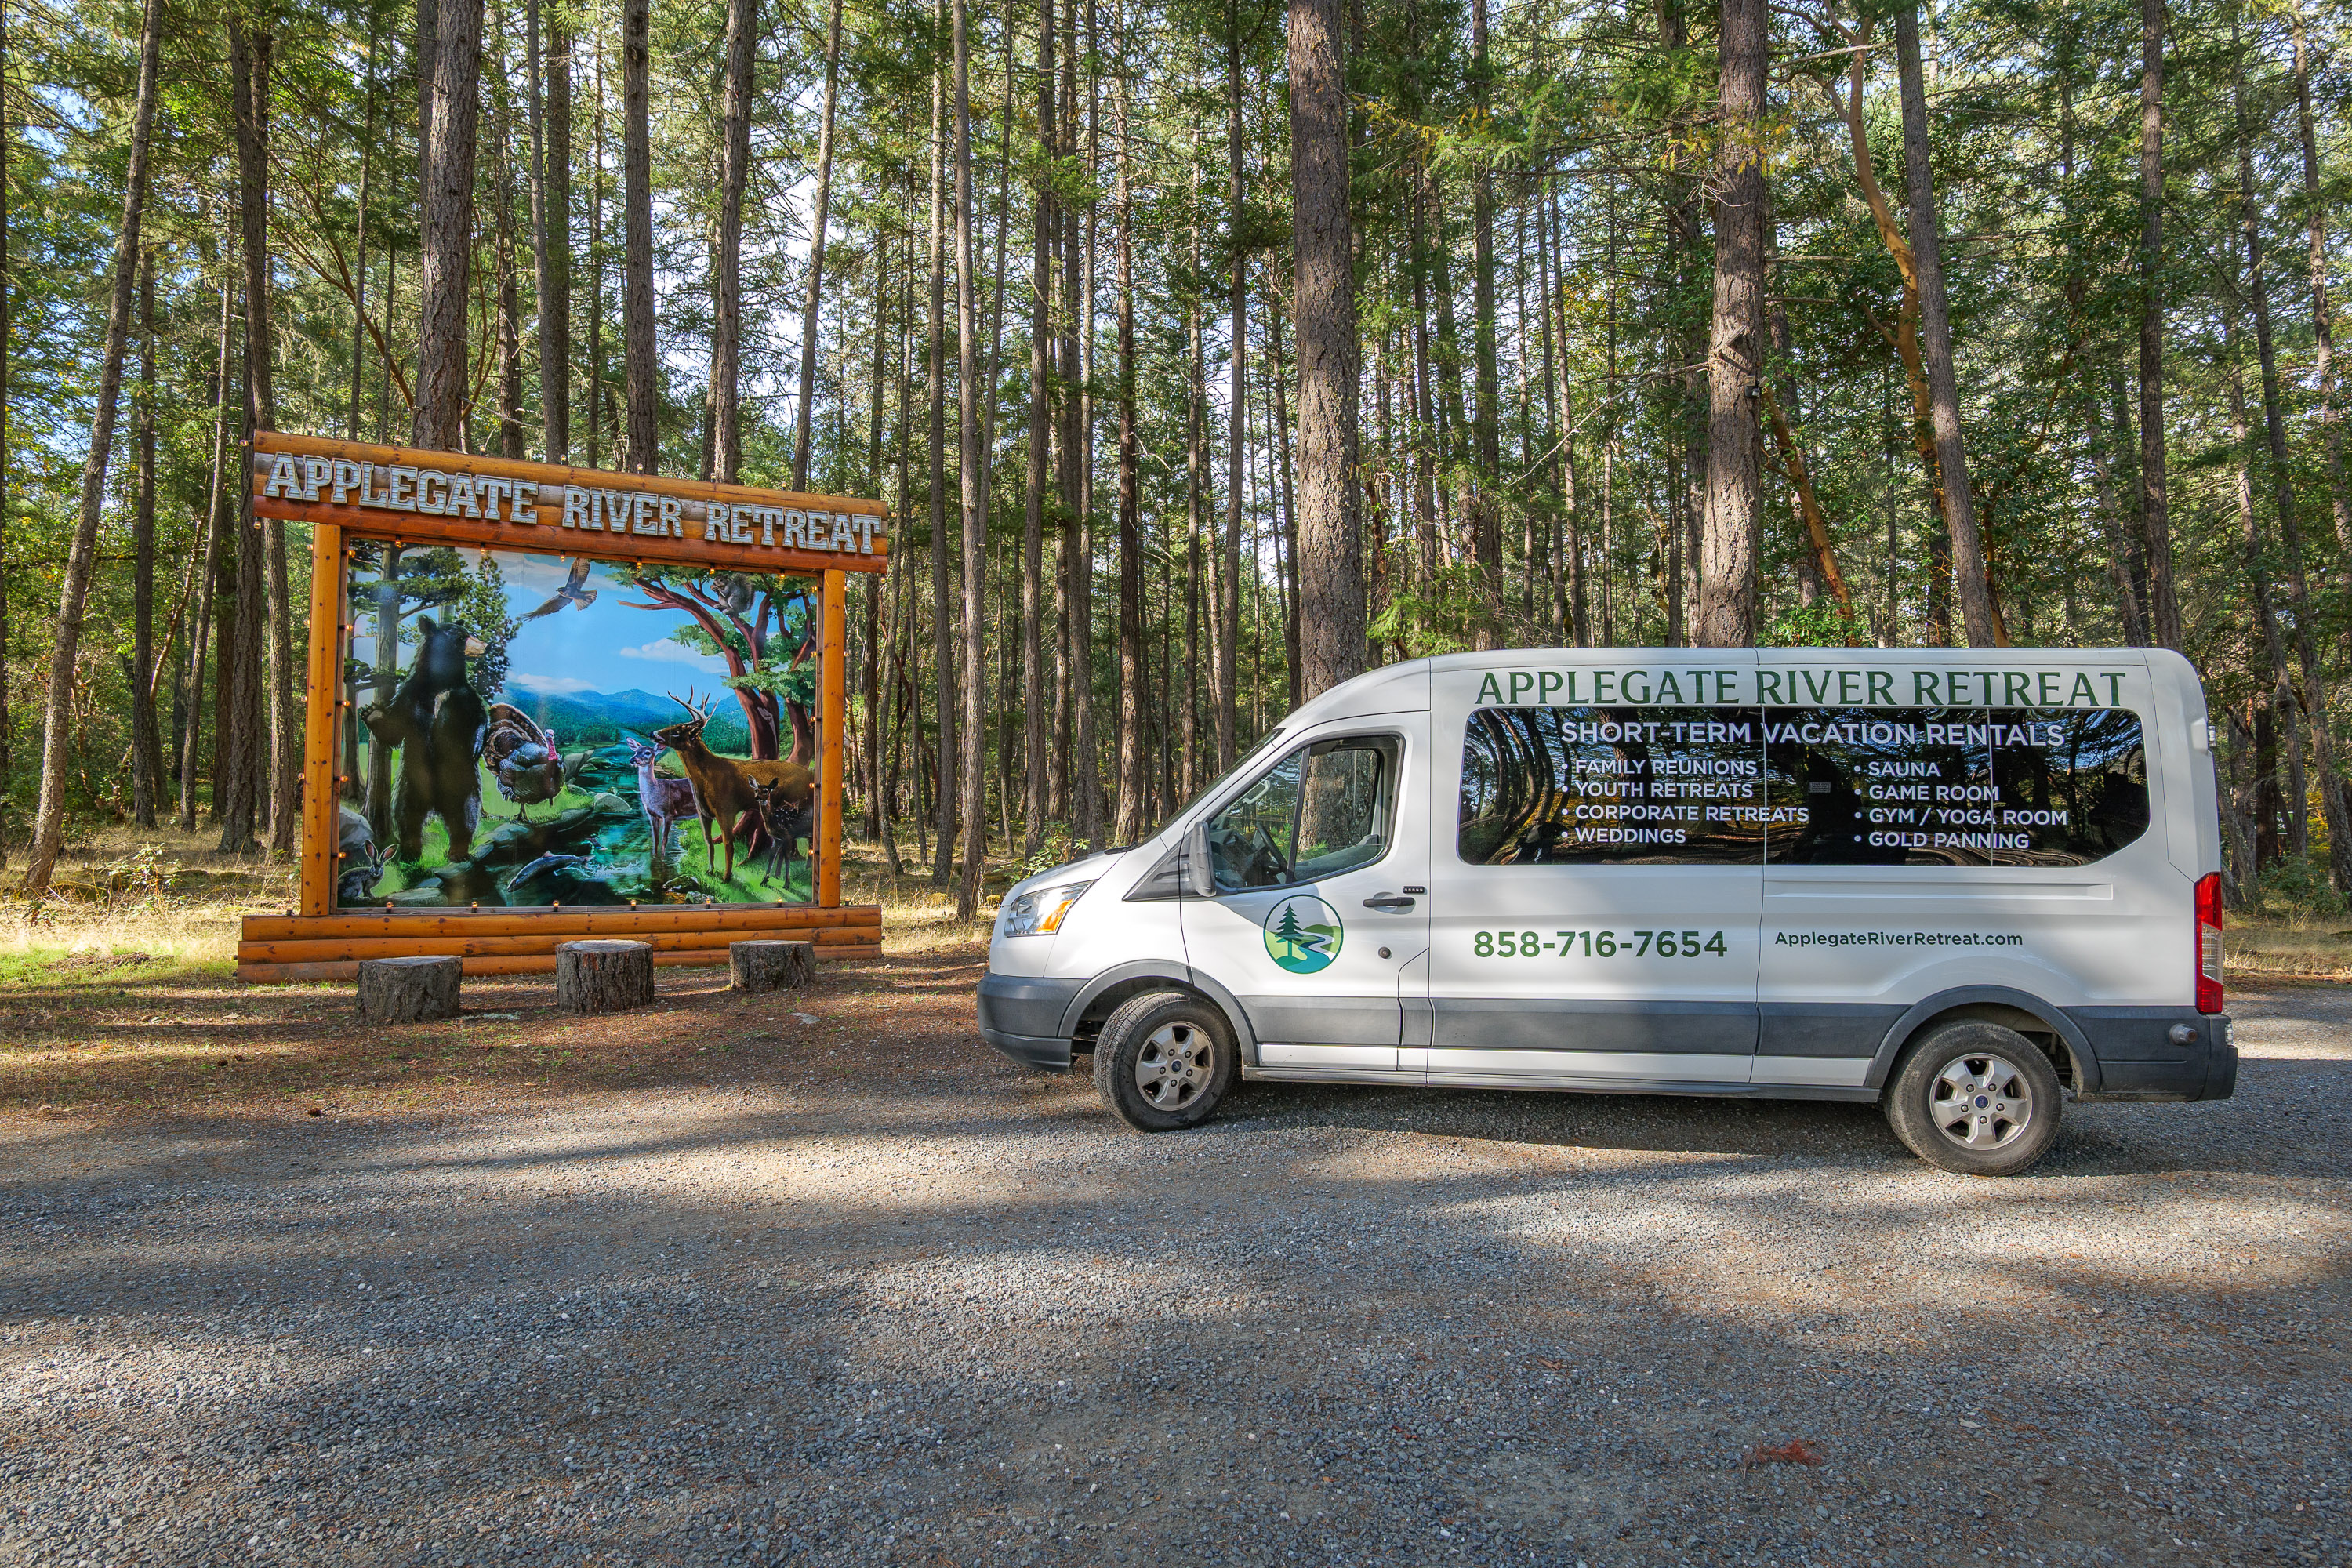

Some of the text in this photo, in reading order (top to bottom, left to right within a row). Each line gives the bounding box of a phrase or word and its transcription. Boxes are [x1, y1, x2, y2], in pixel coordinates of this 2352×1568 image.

[263, 451, 882, 554] APPLEGATE RIVER RETREAT
[1475, 670, 2126, 706] APPLEGATE RIVER RETREAT
[1561, 721, 2066, 746] SHORT-TERM VACATION RENTALS
[1576, 760, 1757, 775] FAMILY REUNIONS
[1868, 761, 1941, 777] SAUNA
[1576, 782, 1753, 798] YOUTH RETREATS
[1869, 786, 1999, 801] GAME ROOM
[1575, 804, 1809, 822] CORPORATE RETREATS
[1869, 808, 1915, 824] GYM
[1936, 809, 1996, 825] YOGA
[2003, 810, 2067, 826] ROOM
[1576, 827, 1686, 843] WEDDINGS
[1869, 832, 2029, 848] GOLD PANNING
[1473, 931, 1727, 957] 858-716-7654
[1775, 931, 2023, 948] ApplegateRiverRetreat.com
